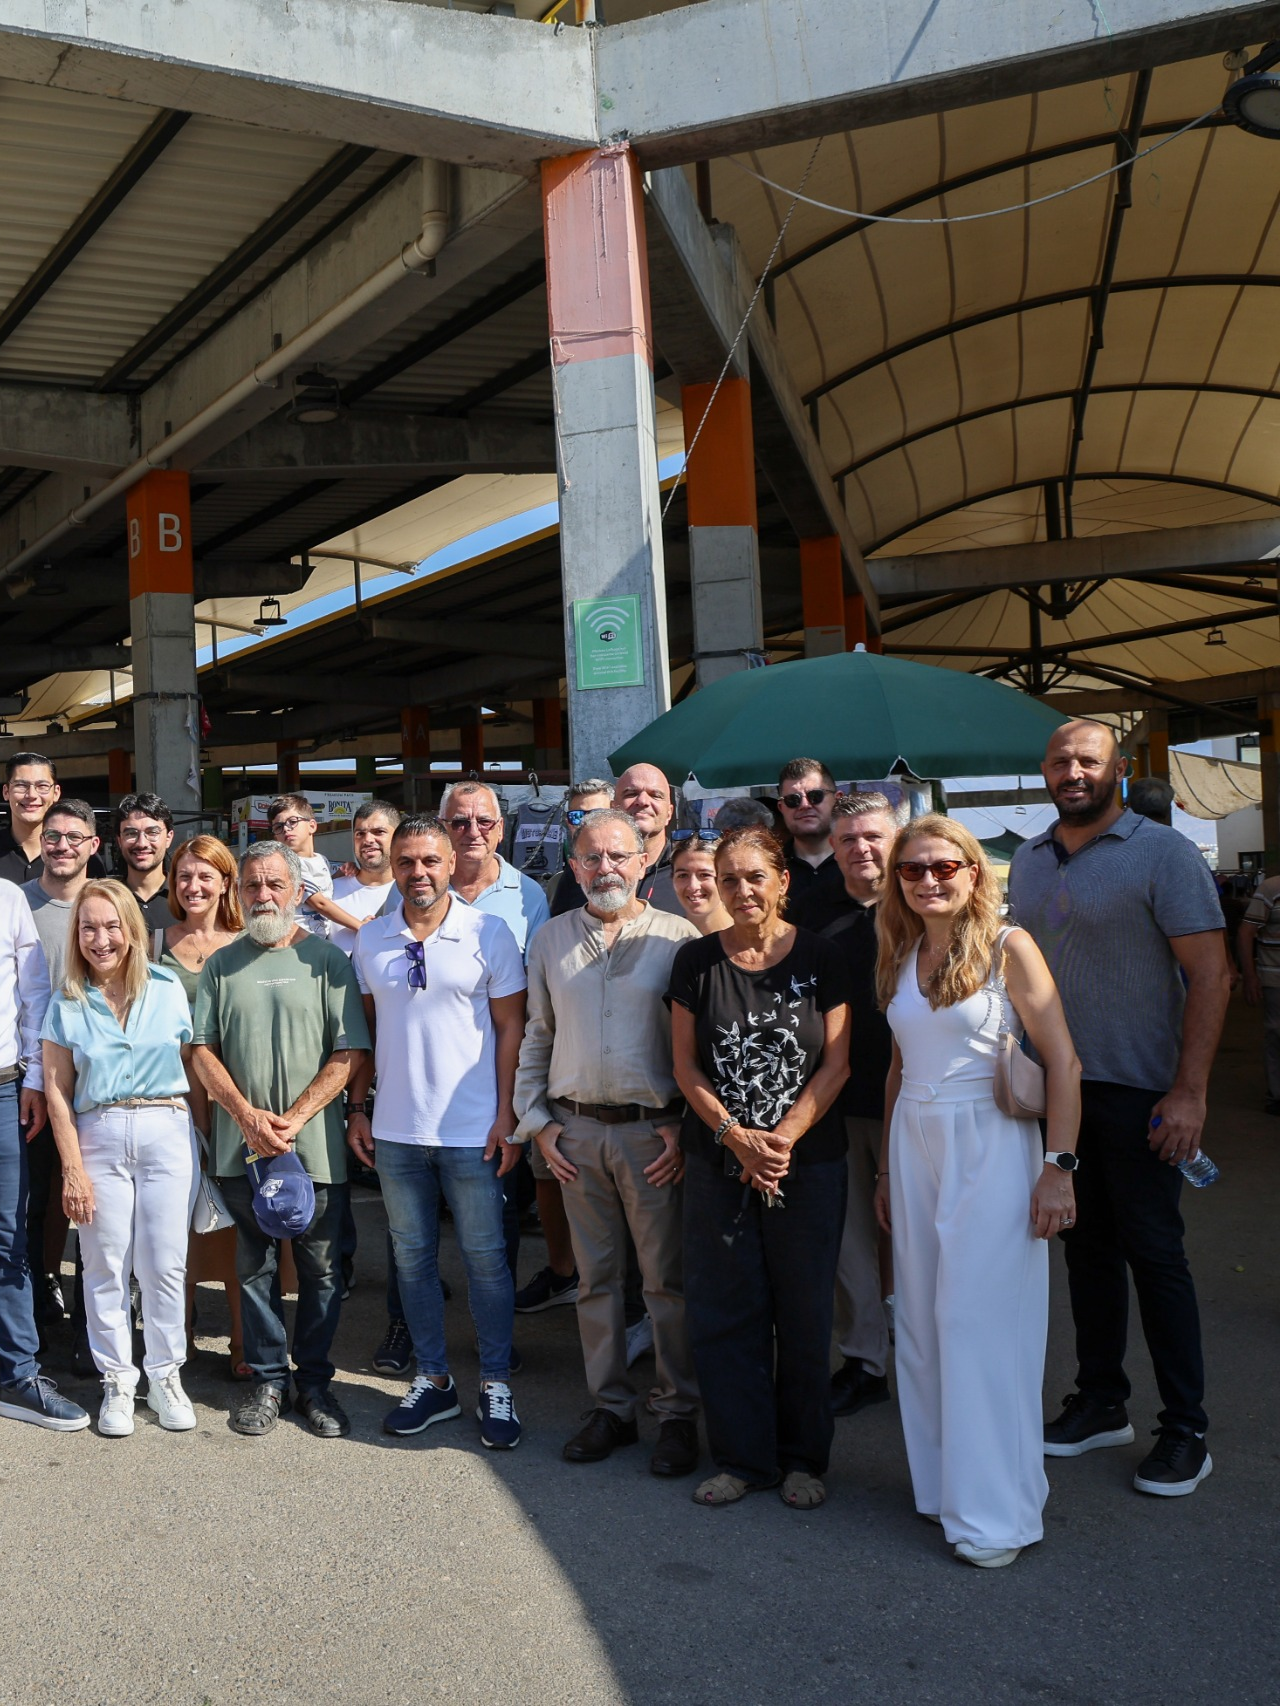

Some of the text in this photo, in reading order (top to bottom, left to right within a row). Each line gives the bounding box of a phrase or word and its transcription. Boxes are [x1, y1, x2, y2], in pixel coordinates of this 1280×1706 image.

[129, 518, 141, 559] B
[159, 512, 182, 552] B
[328, 800, 352, 813] BONITA
